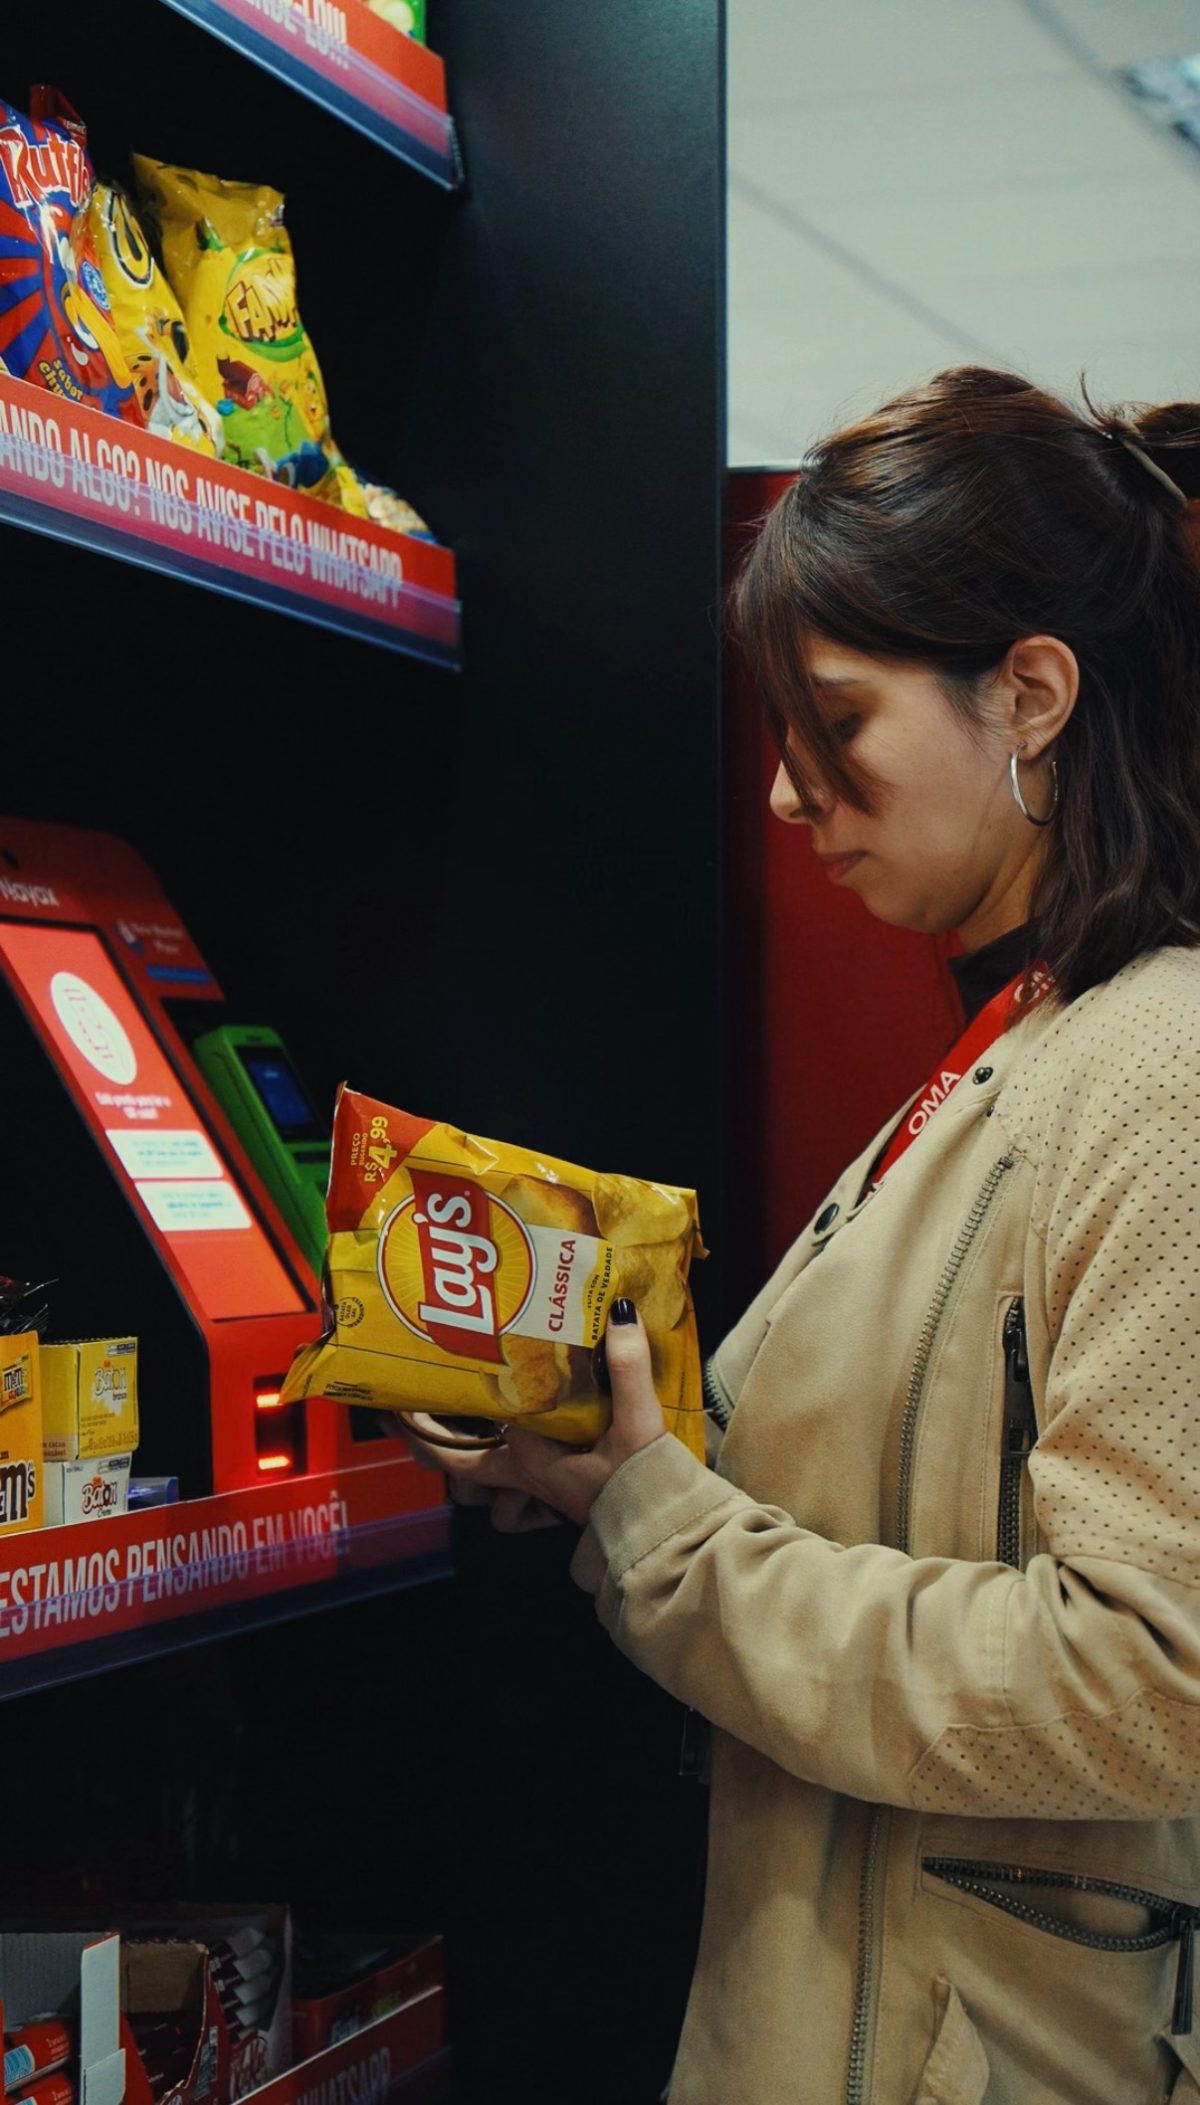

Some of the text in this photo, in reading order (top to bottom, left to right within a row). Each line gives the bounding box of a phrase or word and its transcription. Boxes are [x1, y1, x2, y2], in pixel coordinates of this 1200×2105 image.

[53, 359, 84, 400] sabor
[145, 457, 192, 534] NOS
[195, 477, 255, 558] AVISE
[255, 500, 305, 575] PELO
[307, 519, 403, 608] WHATSAPP
[350, 1132, 361, 1166] PREÇO
[413, 1192, 498, 1336] Lay's
[547, 1239, 576, 1332] CLÁSSICA
[592, 1247, 613, 1341] BATATA DE VERDADE
[82, 1481, 118, 1515] Baton
[0, 1489, 350, 1638] ESTAMOS PENSANDO EM VOCÊ!
